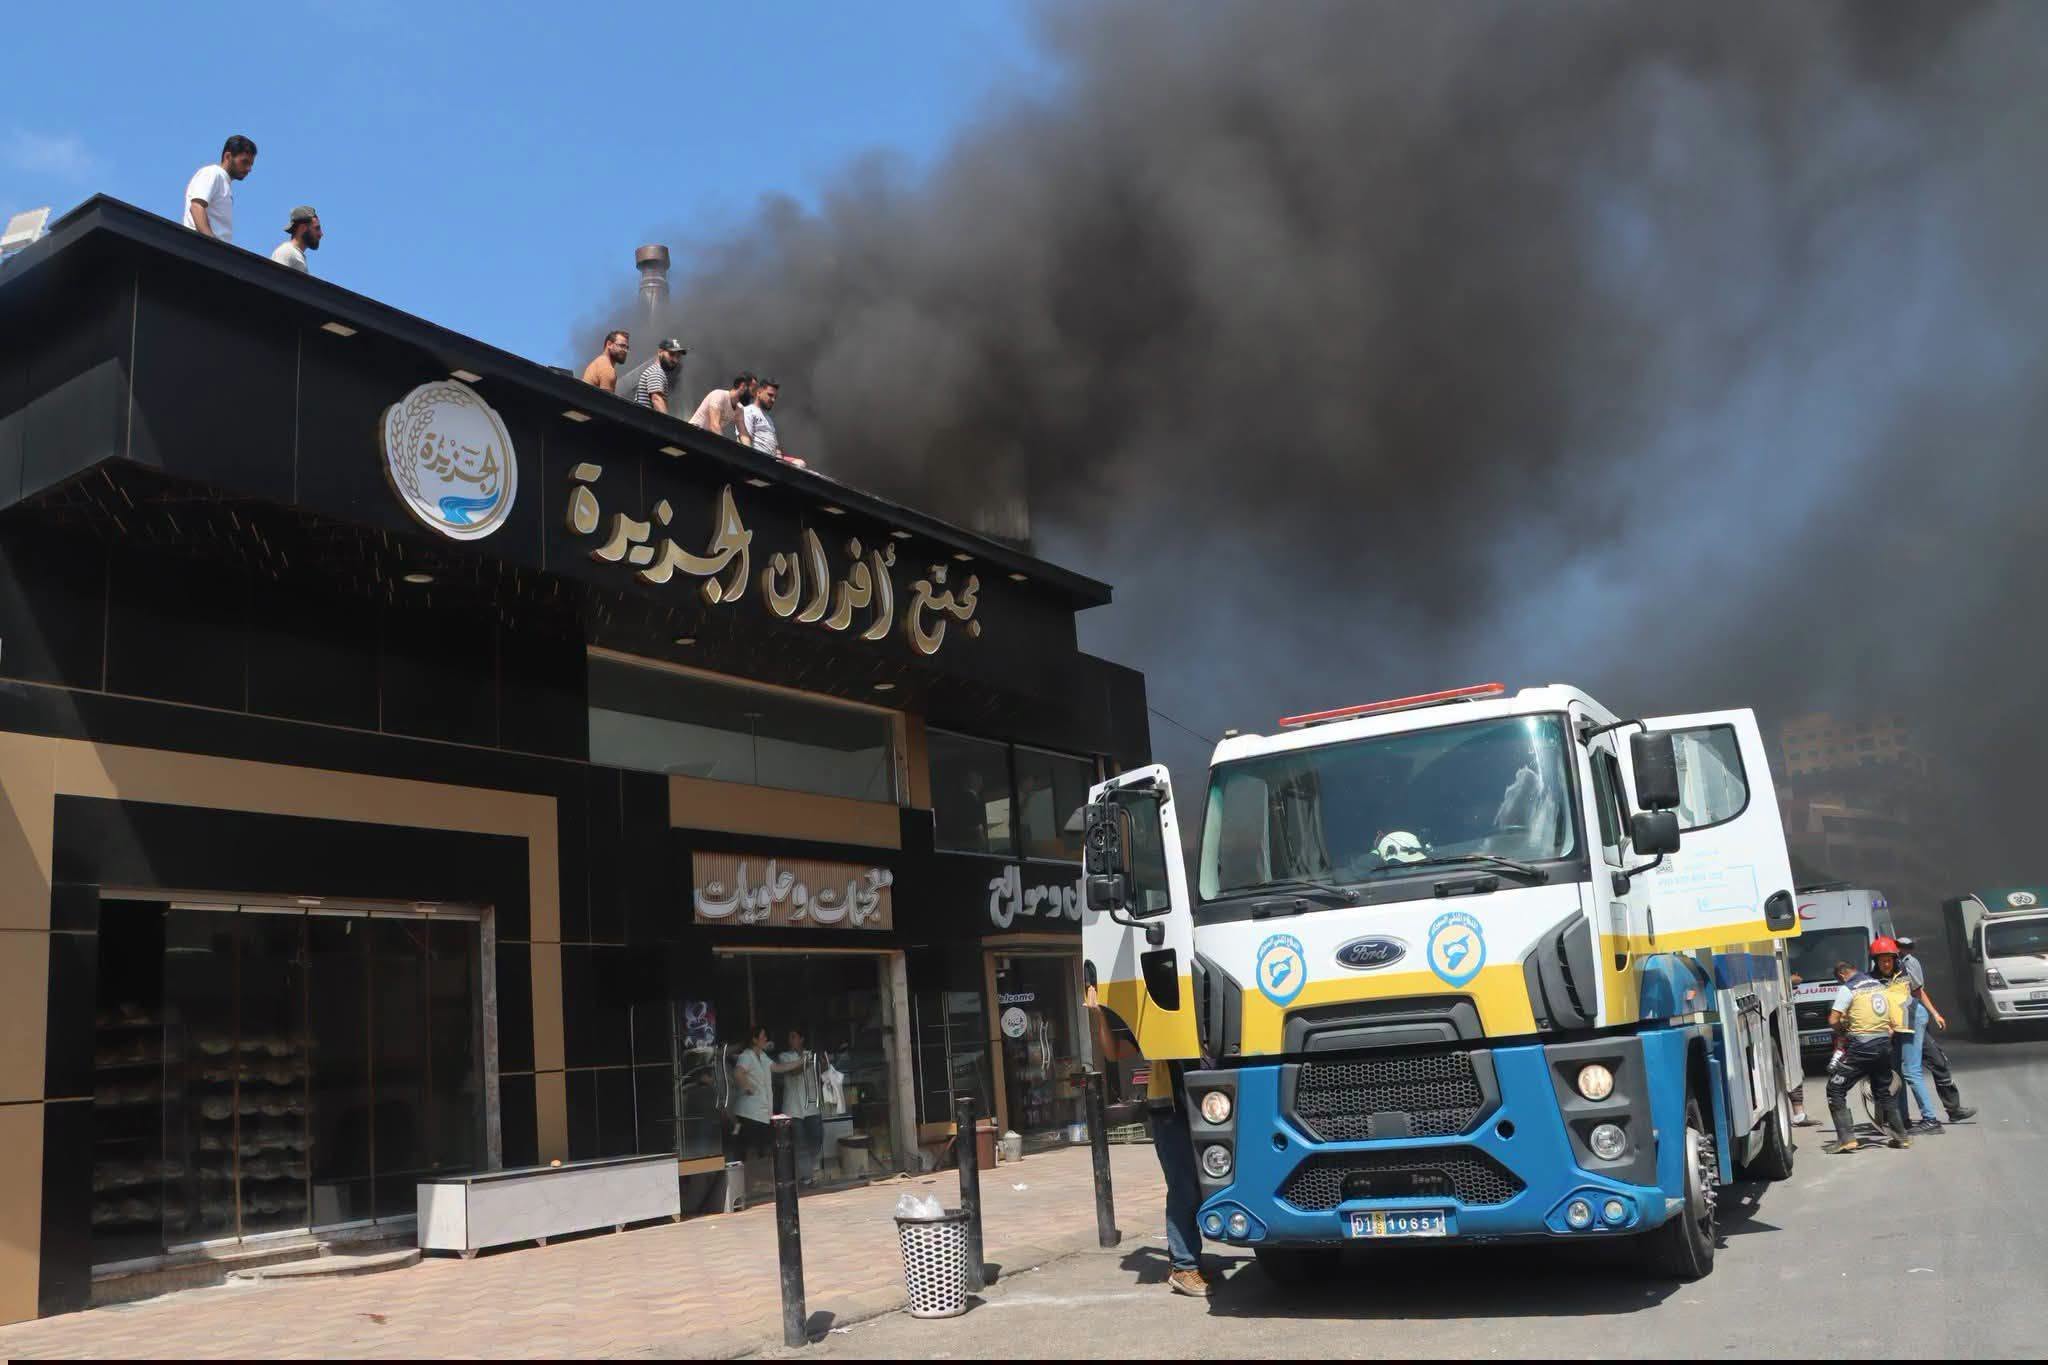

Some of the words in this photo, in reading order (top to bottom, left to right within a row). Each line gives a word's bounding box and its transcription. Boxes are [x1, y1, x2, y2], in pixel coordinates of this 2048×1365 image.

[420, 432, 499, 496] الجزيرة
[566, 462, 752, 604] الجزيرة
[763, 527, 896, 641] أفران
[1350, 943, 1388, 962] Ford
[1387, 1216, 1441, 1231] 10651
